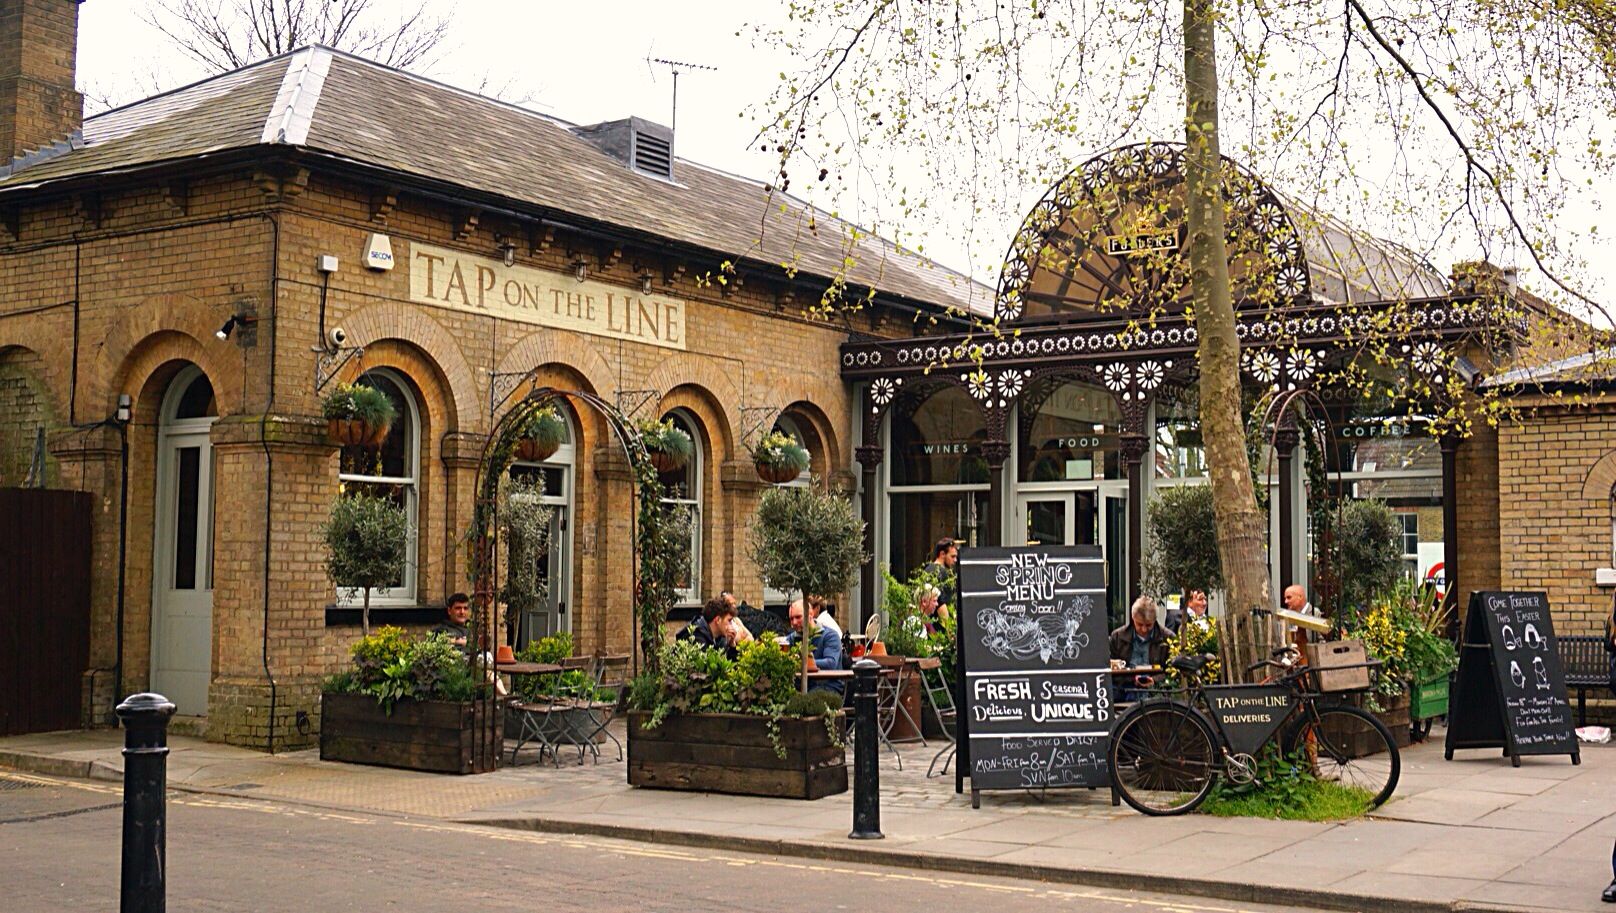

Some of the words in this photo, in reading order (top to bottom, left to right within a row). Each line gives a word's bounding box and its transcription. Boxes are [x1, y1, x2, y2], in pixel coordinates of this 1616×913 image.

[371, 251, 392, 261] SECOM
[416, 251, 496, 309] TAP
[503, 279, 540, 310] ON
[550, 288, 596, 321] THE
[605, 292, 680, 343] LINE
[1342, 425, 1411, 438] COFFEE
[924, 443, 969, 454] WINES
[1058, 438, 1100, 448] FOOD
[1011, 553, 1048, 568] NEW
[996, 563, 1073, 586] SPRING
[1006, 583, 1055, 601] MENU
[998, 600, 1026, 617] Coming
[1040, 681, 1089, 699] Seasonal
[1096, 673, 1109, 721] FOOD
[1215, 697, 1239, 709] TAP
[1240, 698, 1251, 706] ON
[1251, 698, 1264, 706] THE
[1265, 695, 1288, 707] LINE
[1031, 703, 1093, 722] UNIQUE
[1223, 714, 1271, 724] DELIVERIES
[1056, 750, 1075, 768] SAT
